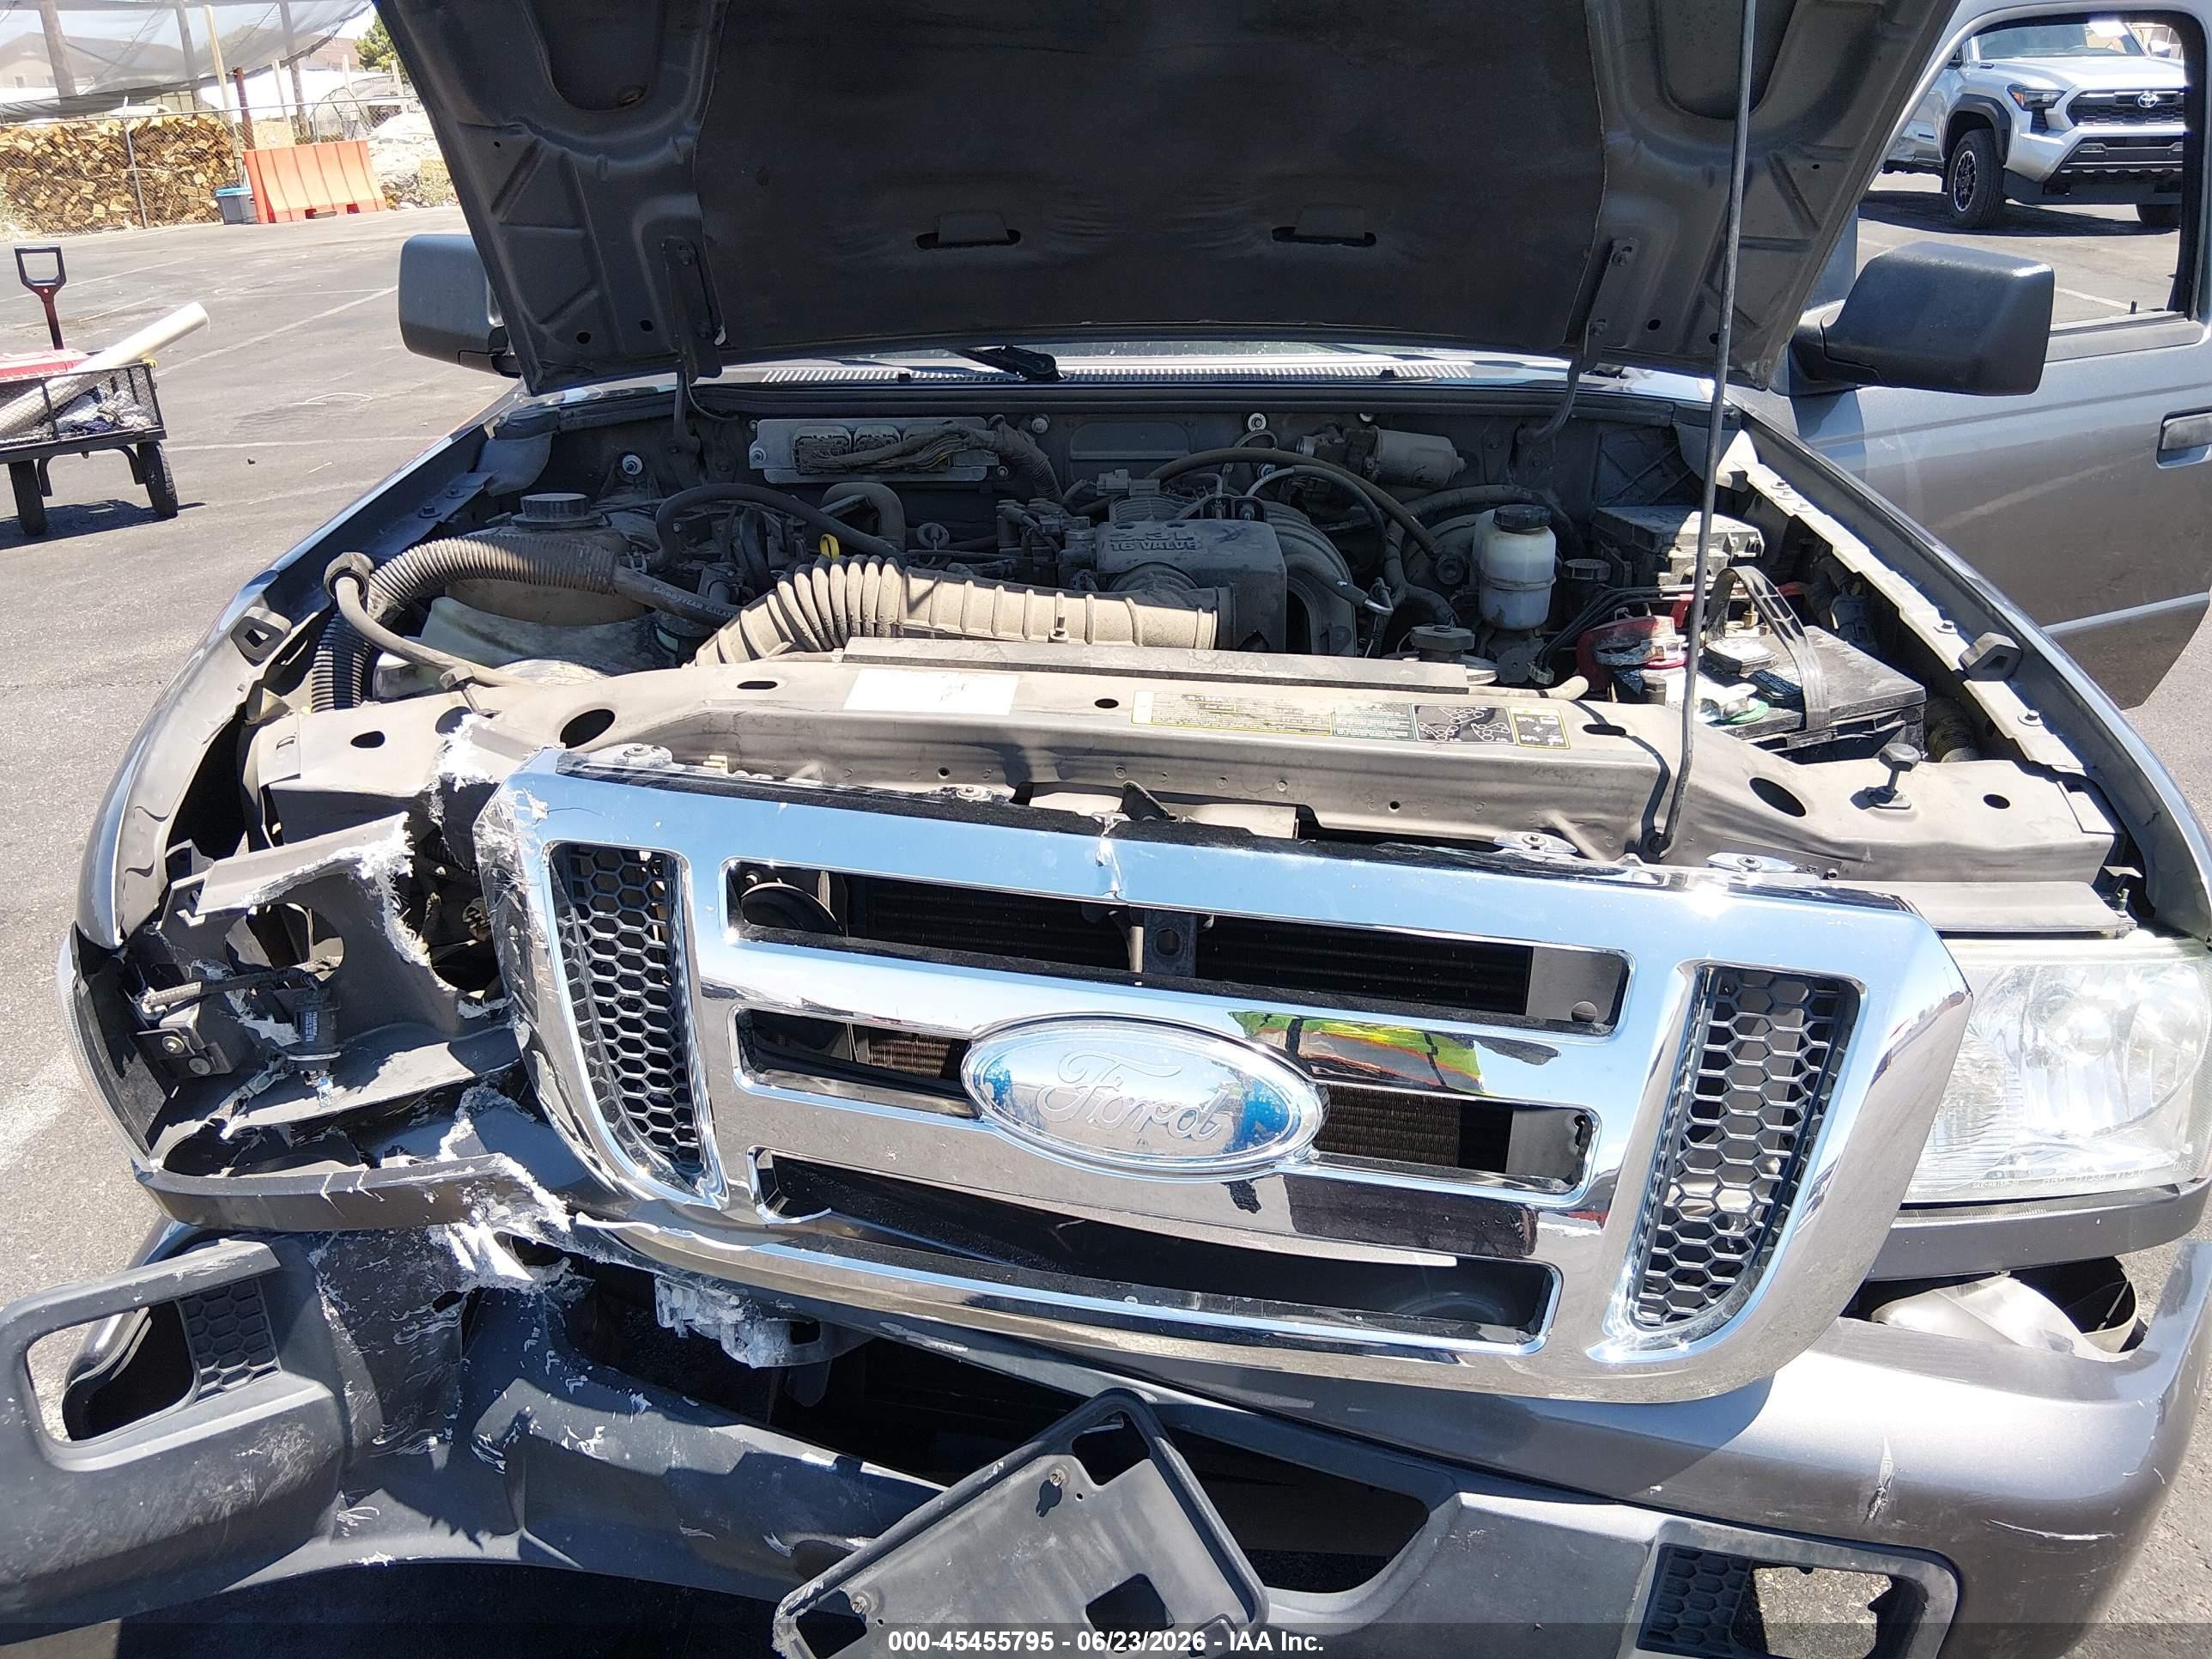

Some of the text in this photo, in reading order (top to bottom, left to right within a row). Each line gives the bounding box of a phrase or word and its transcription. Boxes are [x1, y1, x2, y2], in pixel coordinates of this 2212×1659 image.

[1109, 529, 1195, 543] 2.3L
[1111, 542, 1196, 551] 16 VALVE
[653, 586, 703, 610] GOODYEAR
[1036, 1050, 1224, 1141] Ford
